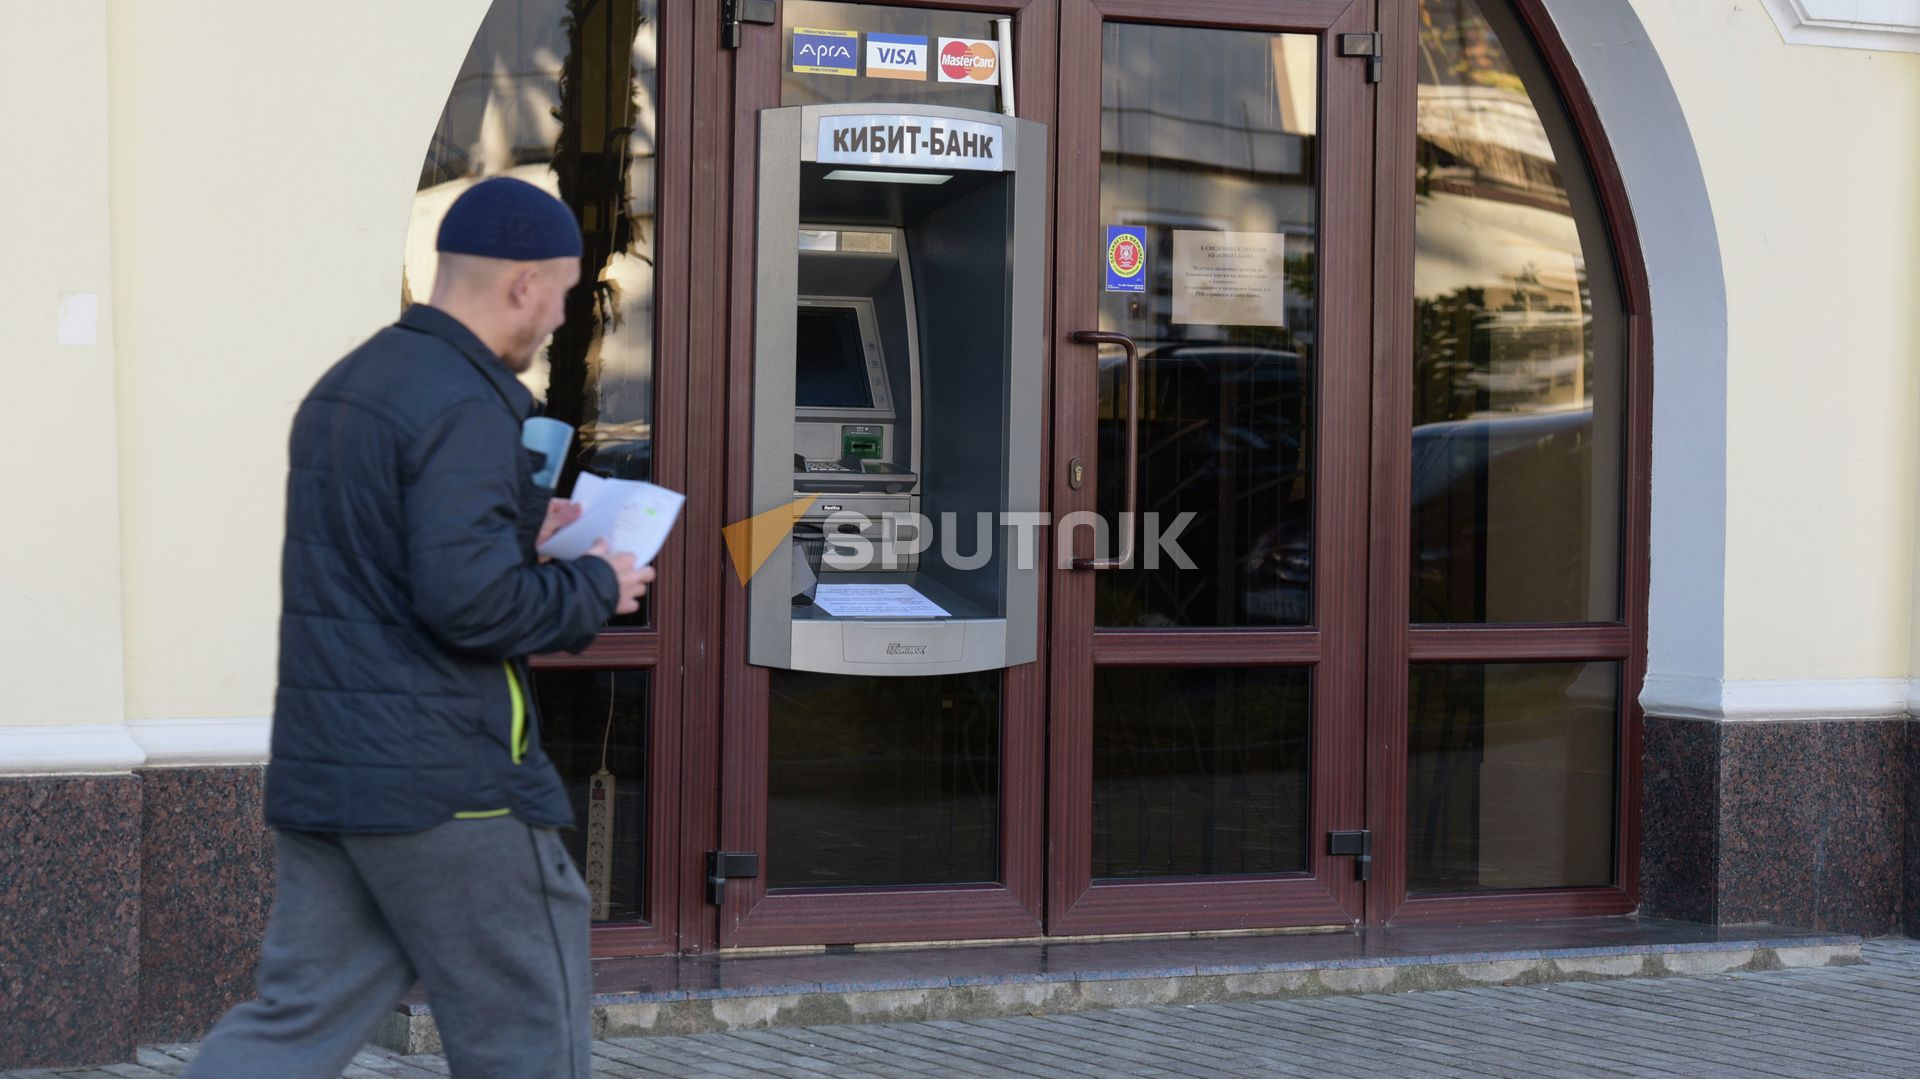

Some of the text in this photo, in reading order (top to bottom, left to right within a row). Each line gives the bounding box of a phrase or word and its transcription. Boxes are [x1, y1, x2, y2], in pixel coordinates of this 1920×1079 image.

[876, 47, 917, 66] VISA
[941, 53, 995, 69] MasterCard
[833, 125, 993, 158] КИБИТ-БАНК
